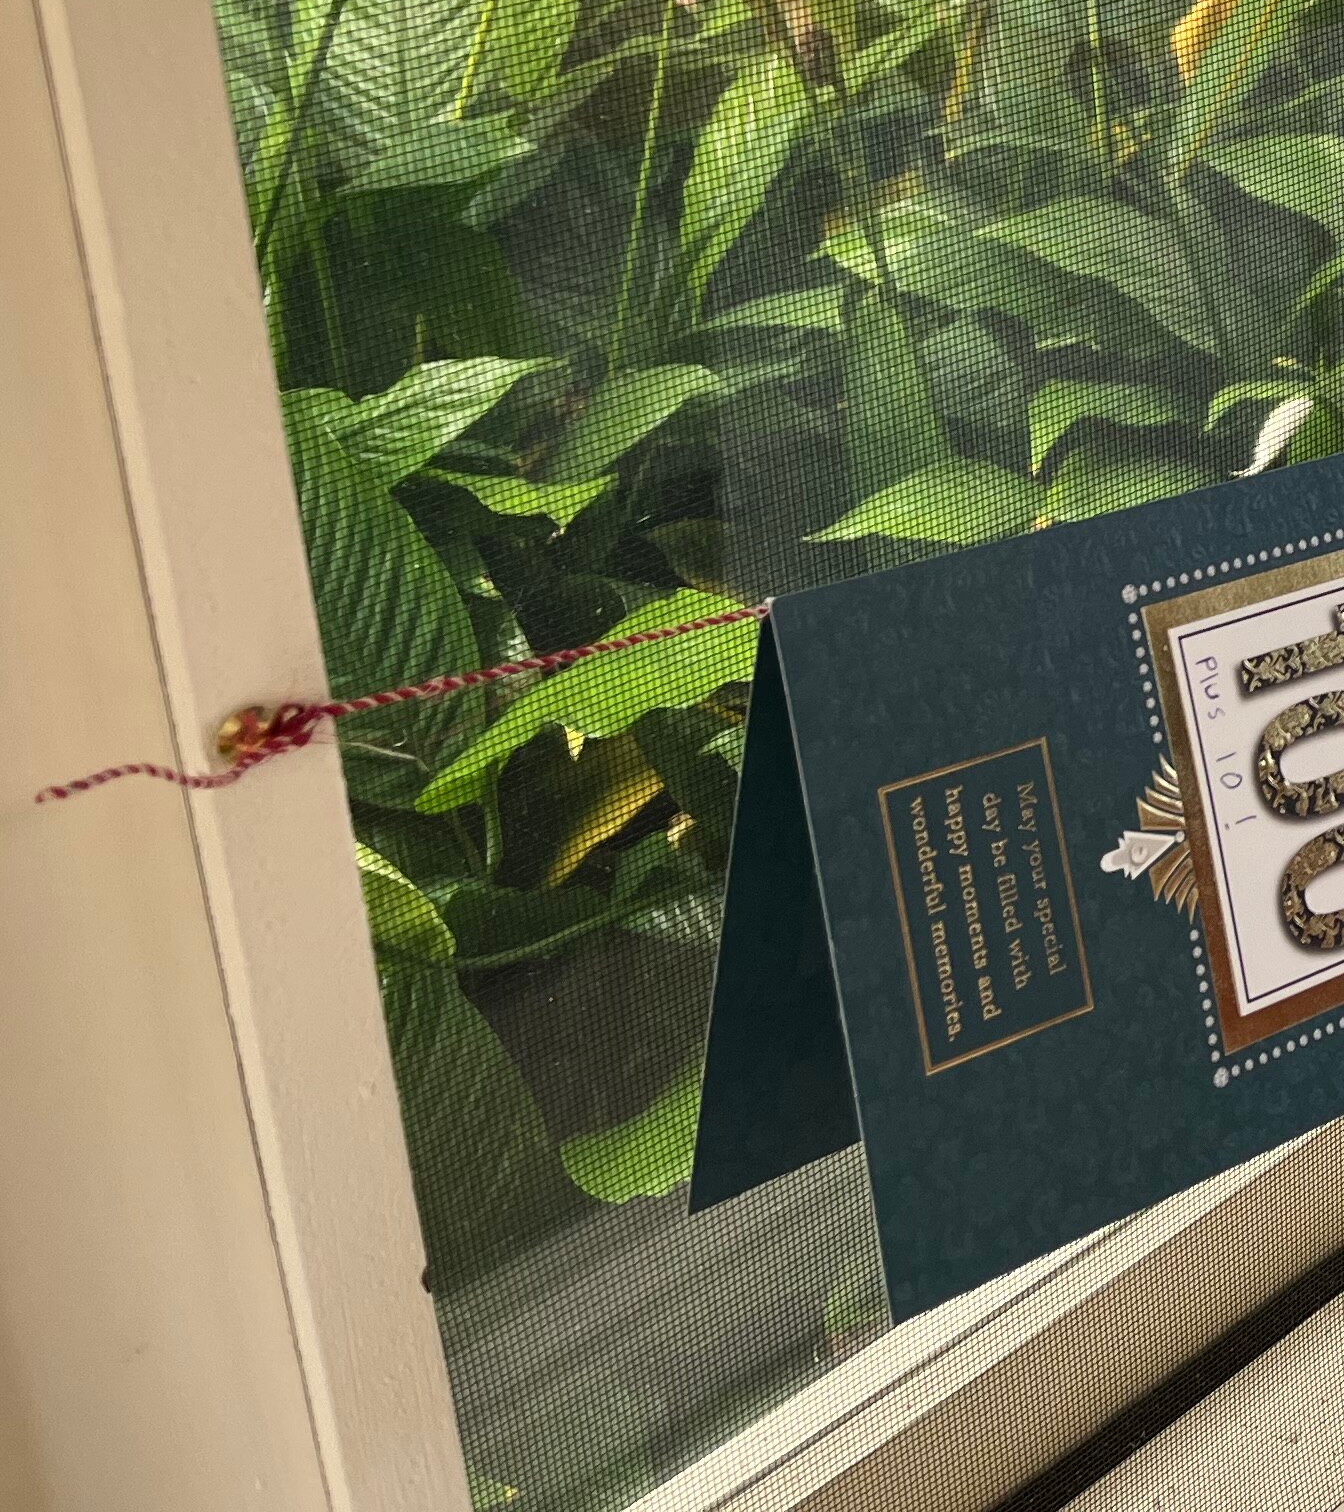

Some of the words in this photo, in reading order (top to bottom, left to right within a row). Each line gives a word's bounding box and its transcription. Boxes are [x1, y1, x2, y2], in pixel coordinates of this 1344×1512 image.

[982, 792, 1001, 833] day
[1017, 781, 1038, 833] May
[991, 839, 1008, 868] be
[1021, 839, 1046, 890] your
[910, 796, 947, 916] wonderful
[931, 920, 964, 1043] memories.
[944, 785, 969, 857] happy
[958, 863, 989, 969] moments
[978, 974, 1002, 1021] and
[997, 873, 1024, 934] filled
[1033, 896, 1067, 975] special
[1008, 937, 1032, 991] with
